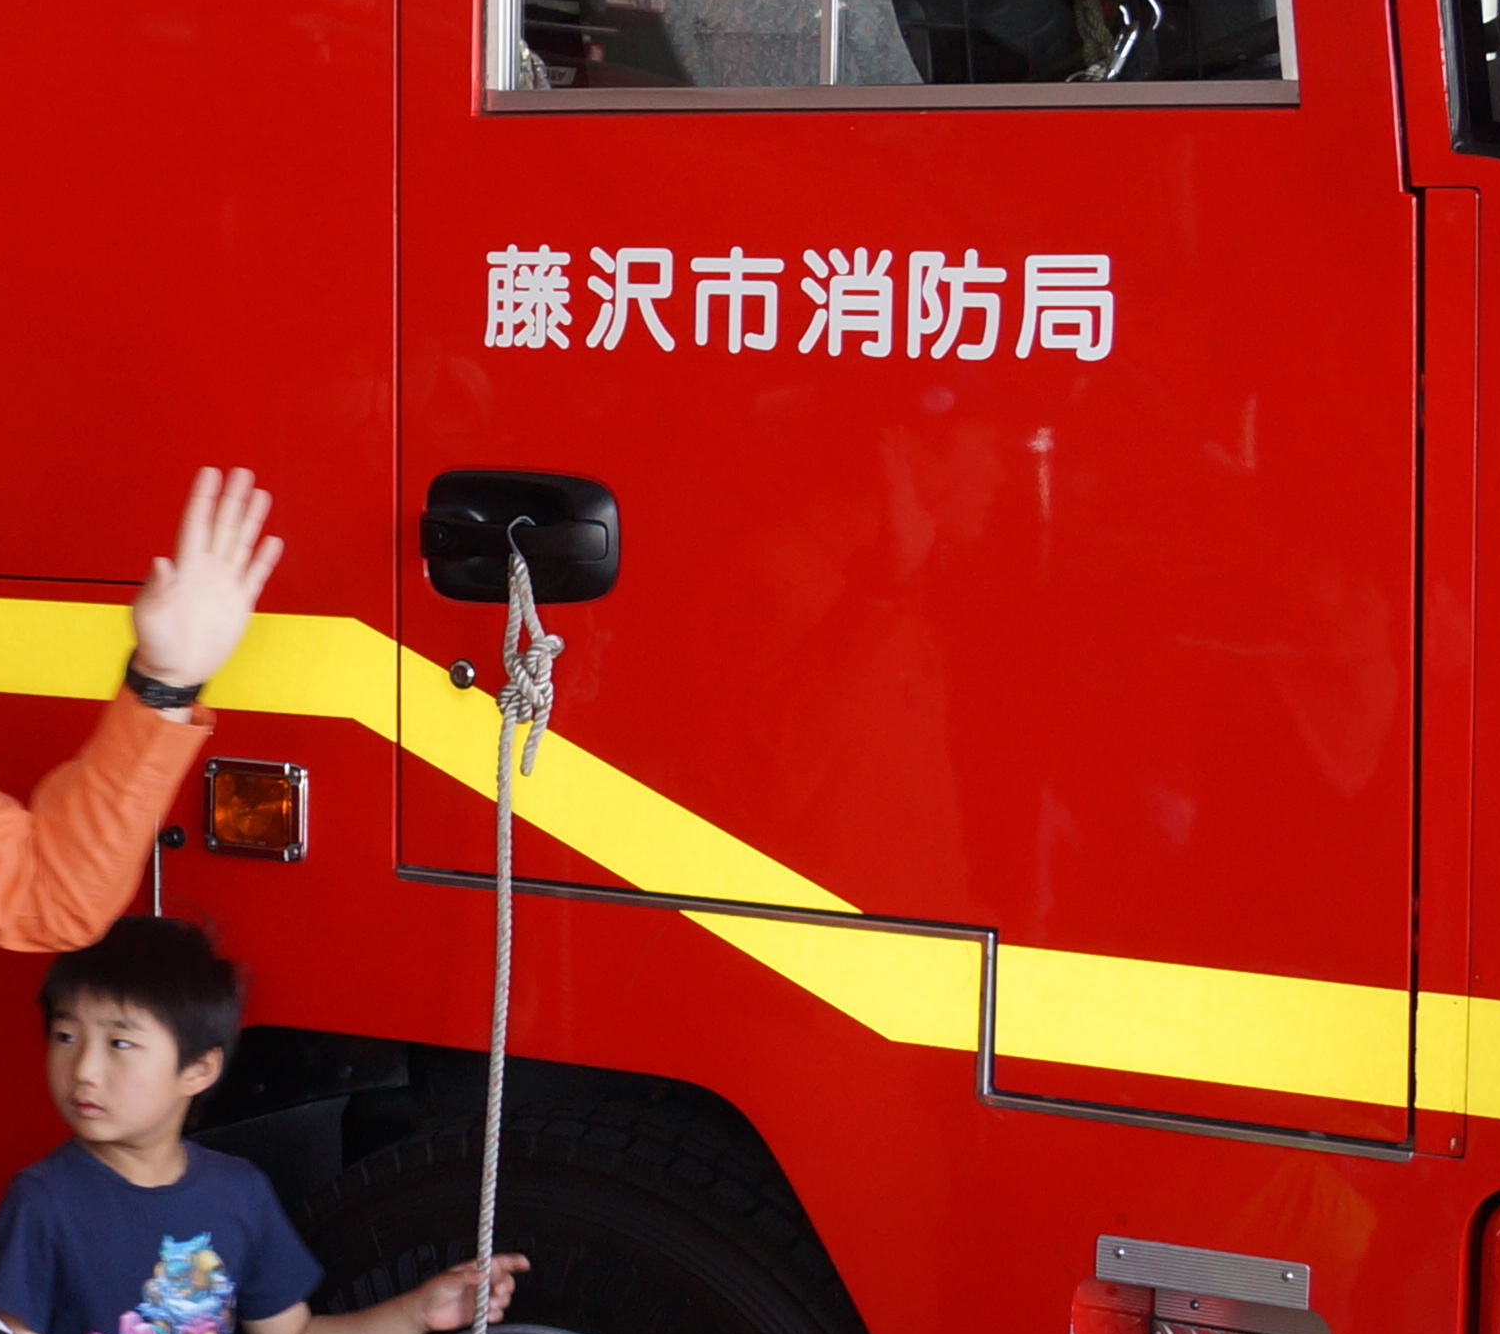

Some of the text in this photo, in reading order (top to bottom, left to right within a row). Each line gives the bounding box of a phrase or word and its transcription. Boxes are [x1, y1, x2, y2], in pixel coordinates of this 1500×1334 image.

[484, 244, 1115, 362] 藤沢市消防局
